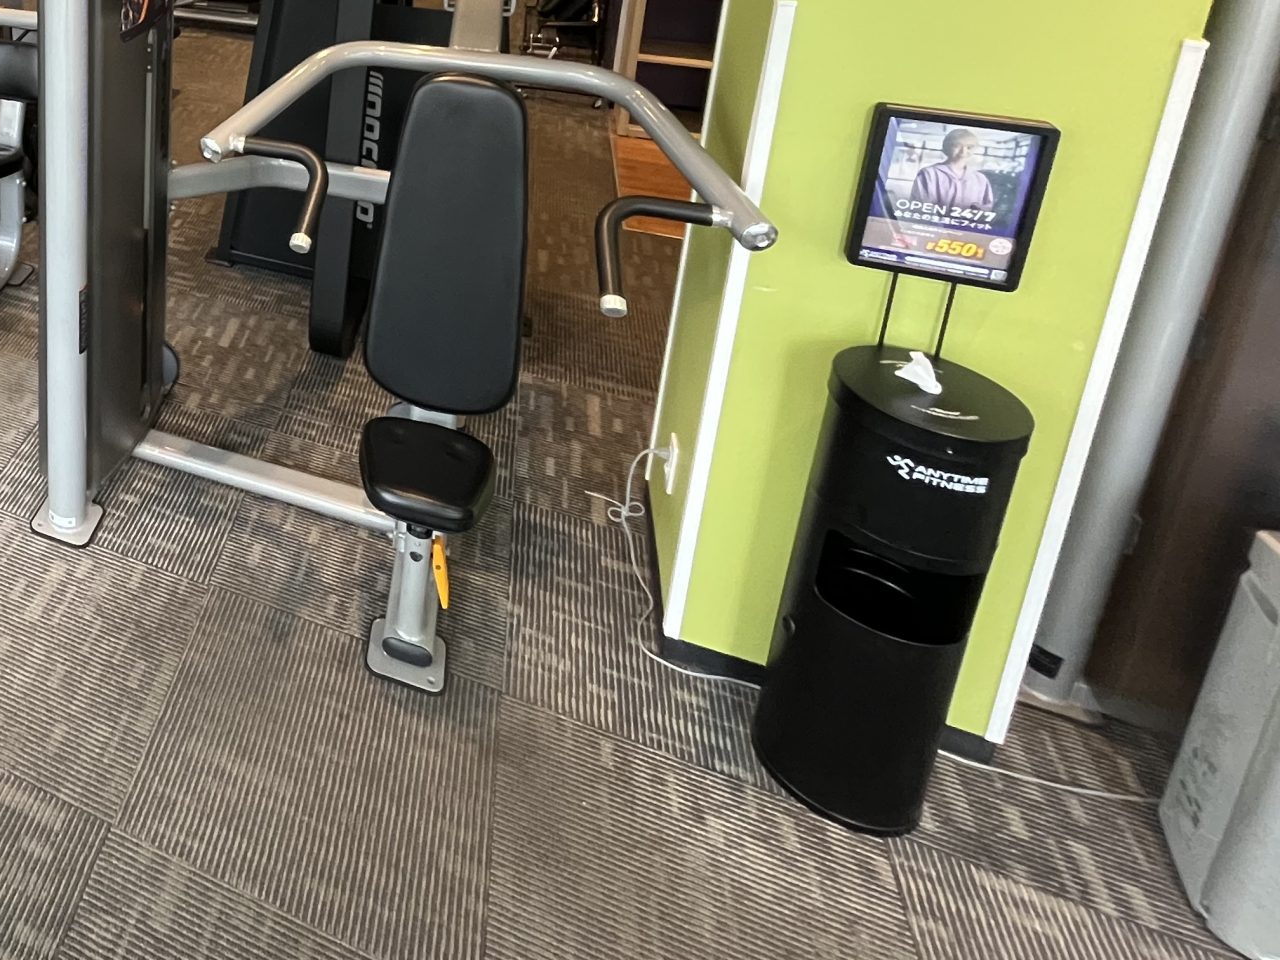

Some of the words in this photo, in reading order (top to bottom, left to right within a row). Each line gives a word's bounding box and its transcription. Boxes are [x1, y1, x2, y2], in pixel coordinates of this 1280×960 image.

[895, 199, 947, 216] OPEN
[950, 206, 997, 222] 24/7
[912, 472, 987, 494] FITNESS
[914, 465, 990, 486] ANYTIME
